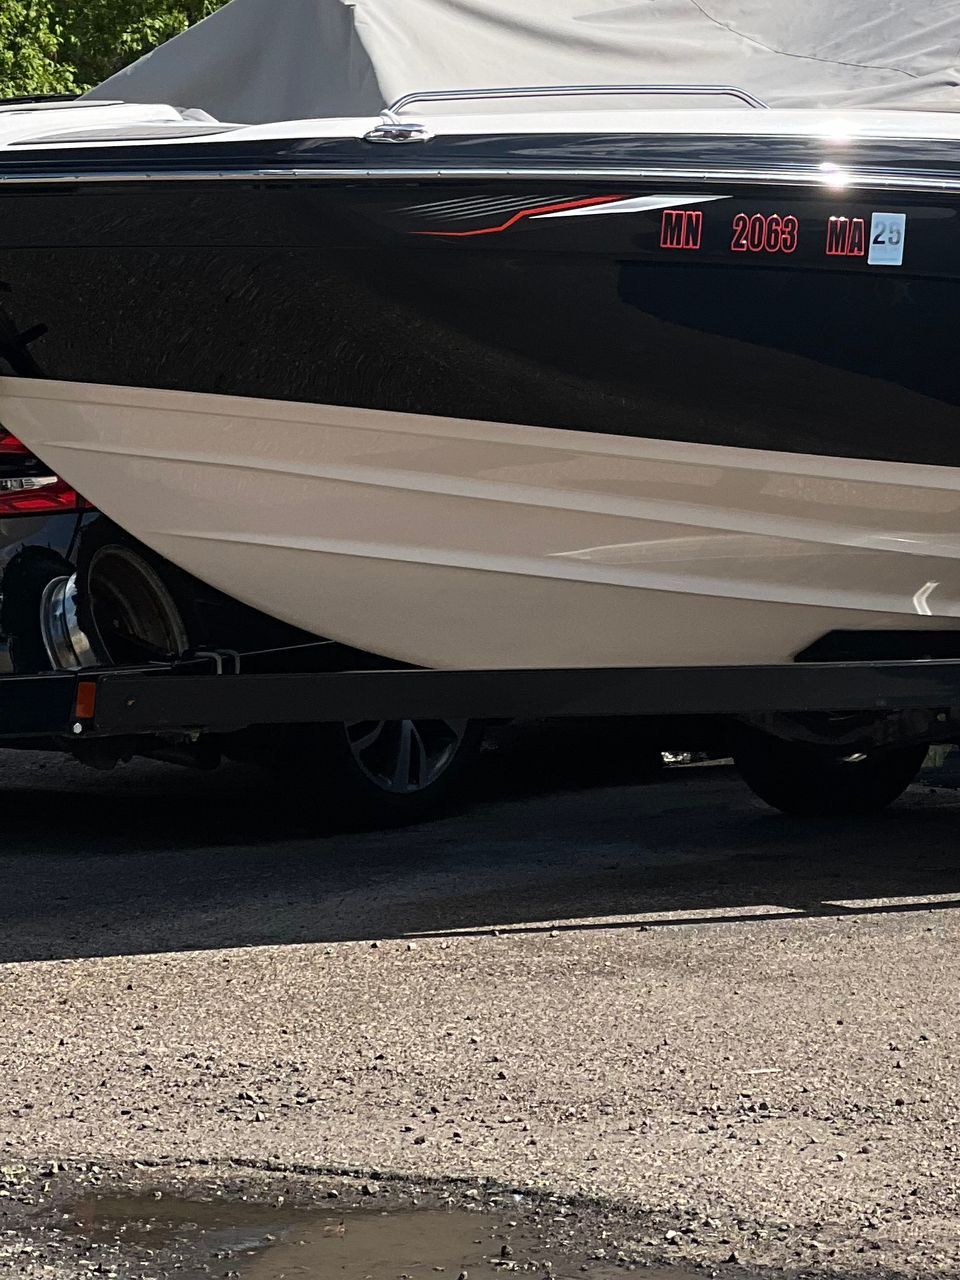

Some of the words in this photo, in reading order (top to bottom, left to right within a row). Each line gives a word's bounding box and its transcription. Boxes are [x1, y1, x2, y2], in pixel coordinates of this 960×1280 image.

[660, 210, 702, 249] MN
[731, 213, 798, 253] 2063
[826, 216, 865, 256] MA
[872, 220, 902, 246] 25
